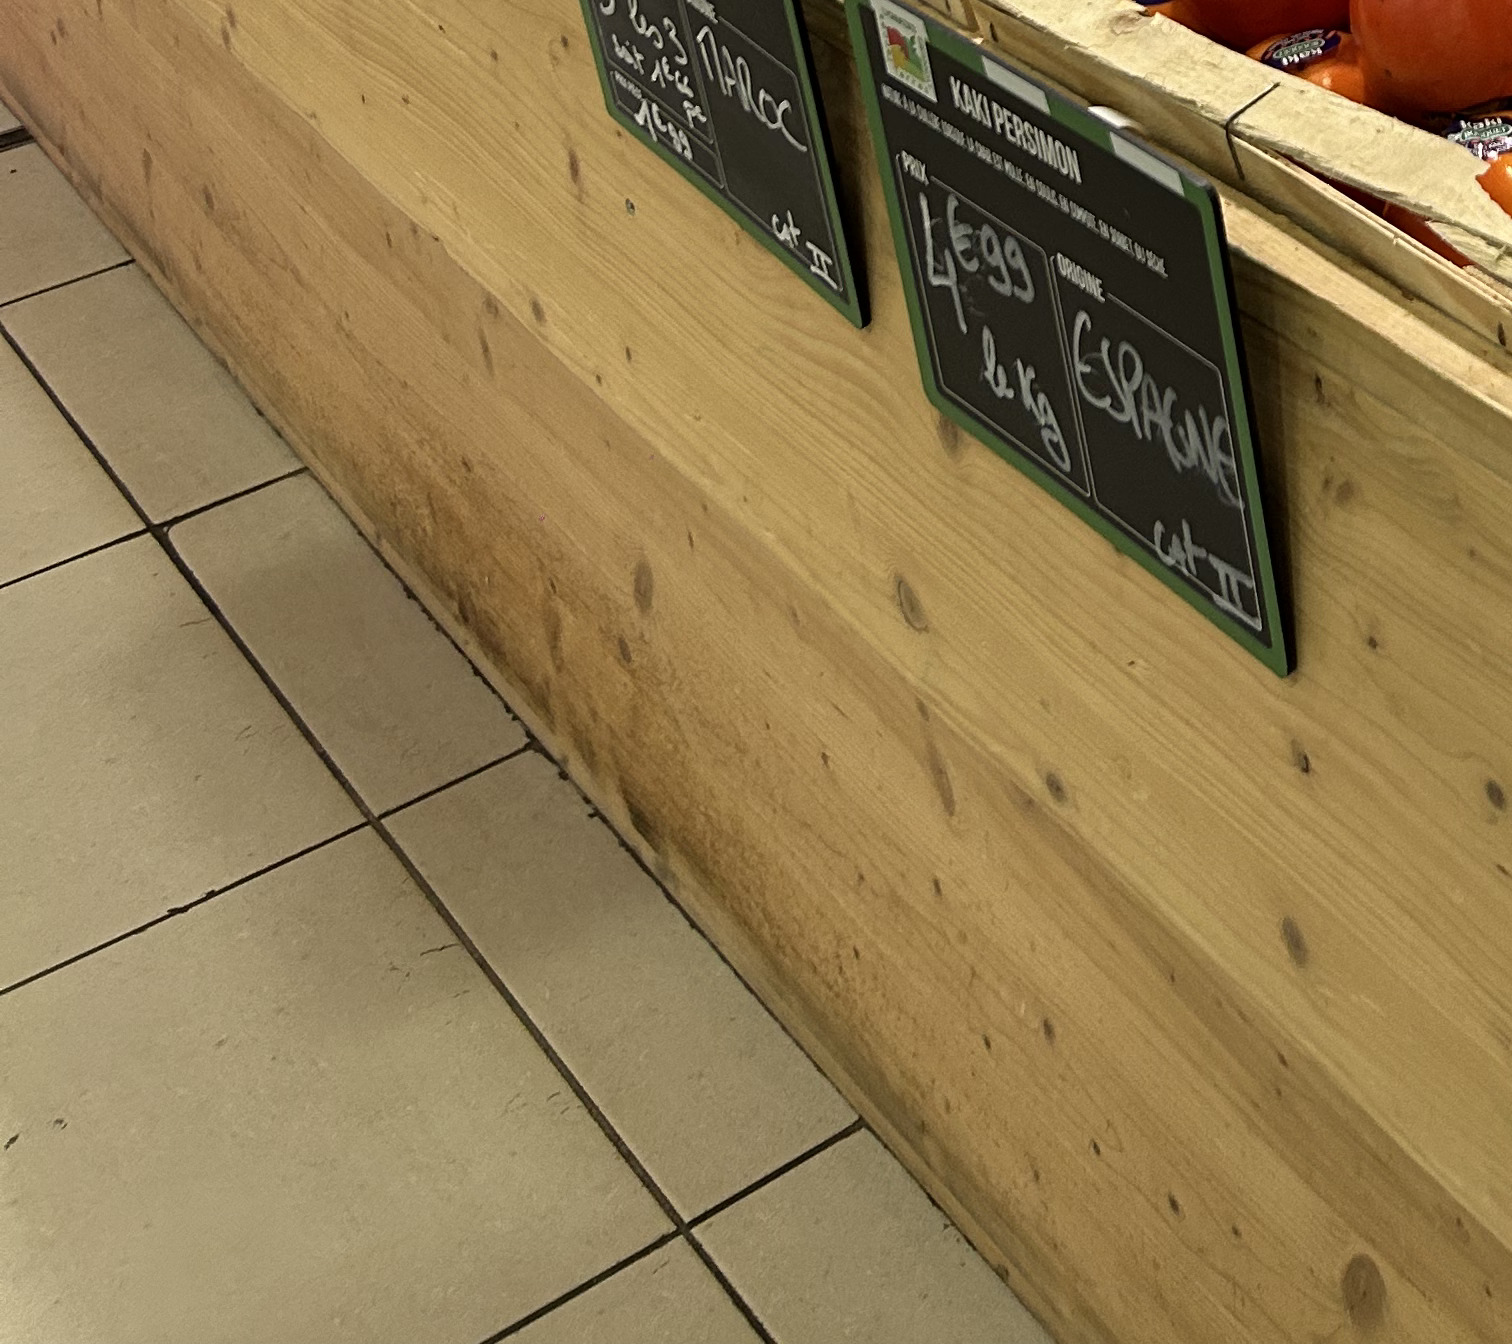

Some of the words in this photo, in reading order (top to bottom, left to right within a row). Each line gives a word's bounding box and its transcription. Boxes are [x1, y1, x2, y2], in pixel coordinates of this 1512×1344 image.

[900, 150, 930, 190] PRIX
[949, 75, 991, 137] KAKI
[991, 101, 1082, 186] PERSIMON
[1055, 251, 1106, 305] ORIGINE
[1070, 309, 1244, 511] ESPAGNE
